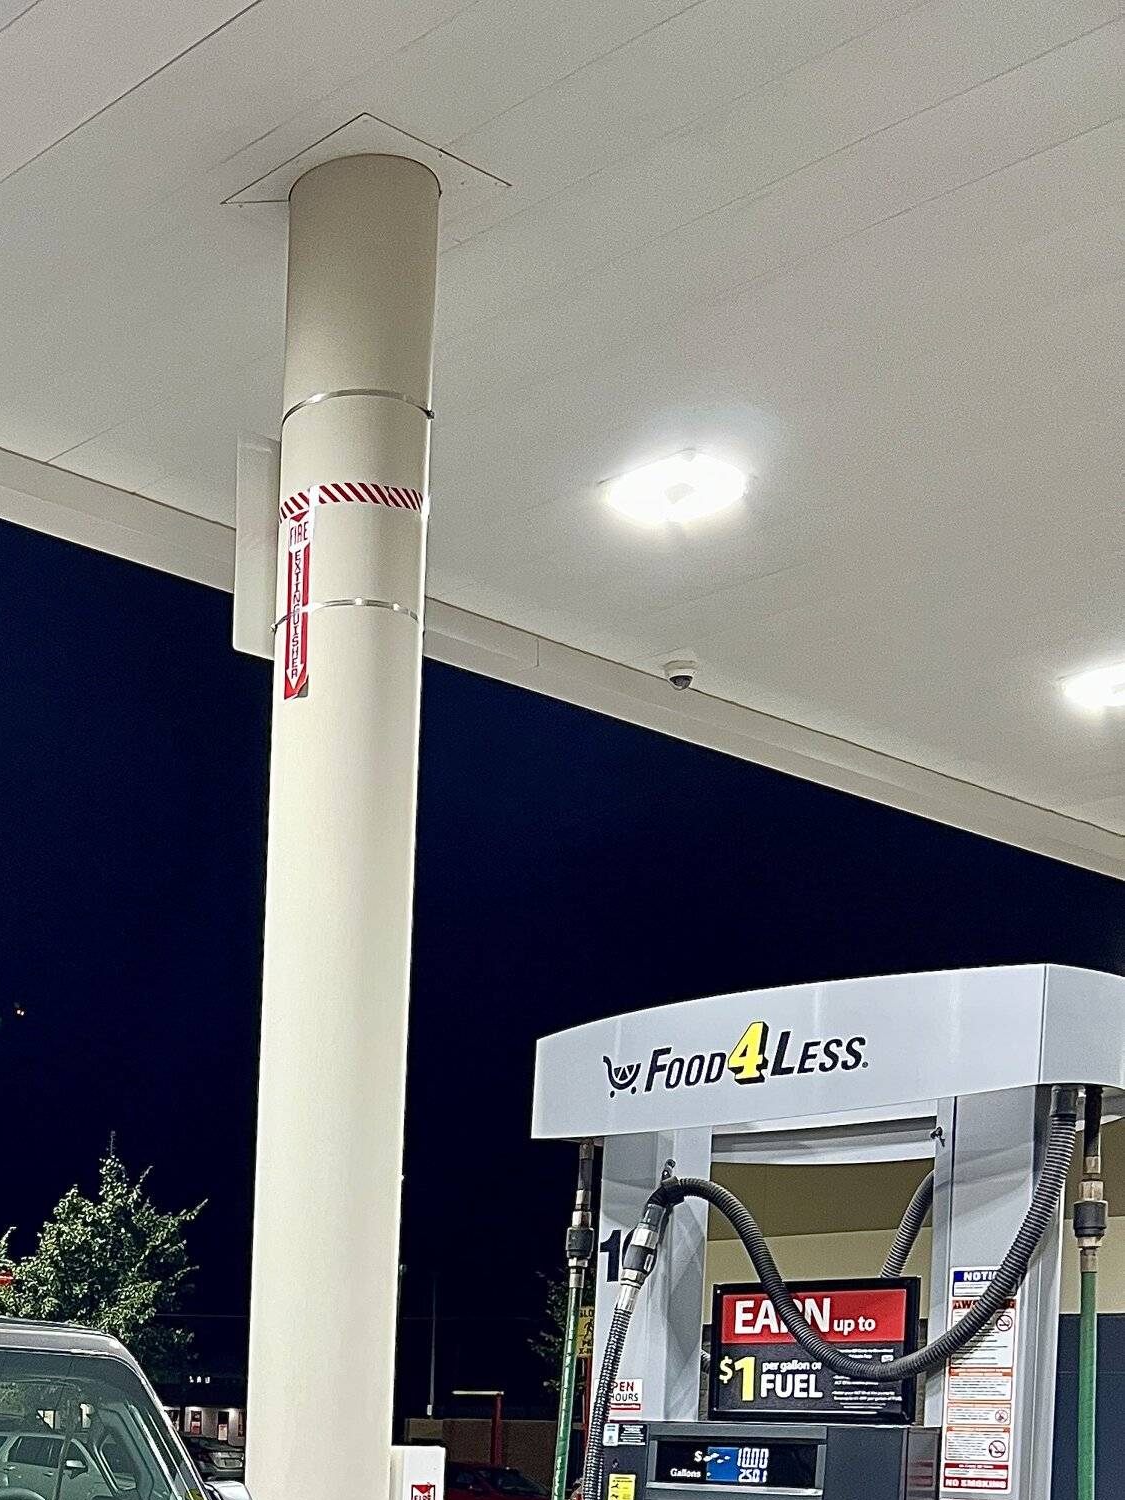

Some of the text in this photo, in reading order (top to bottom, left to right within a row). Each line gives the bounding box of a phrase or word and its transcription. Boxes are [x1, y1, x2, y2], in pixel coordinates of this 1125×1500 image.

[290, 521, 309, 547] FIRE
[291, 550, 302, 678] EXTINGUISHER
[963, 1271, 996, 1281] NOTI
[833, 1319, 855, 1336] up
[858, 1316, 876, 1332] to
[762, 1362, 779, 1373] per
[780, 1359, 810, 1373] gallon
[760, 1373, 824, 1398] FUEL
[670, 1468, 702, 1479] Gallons
